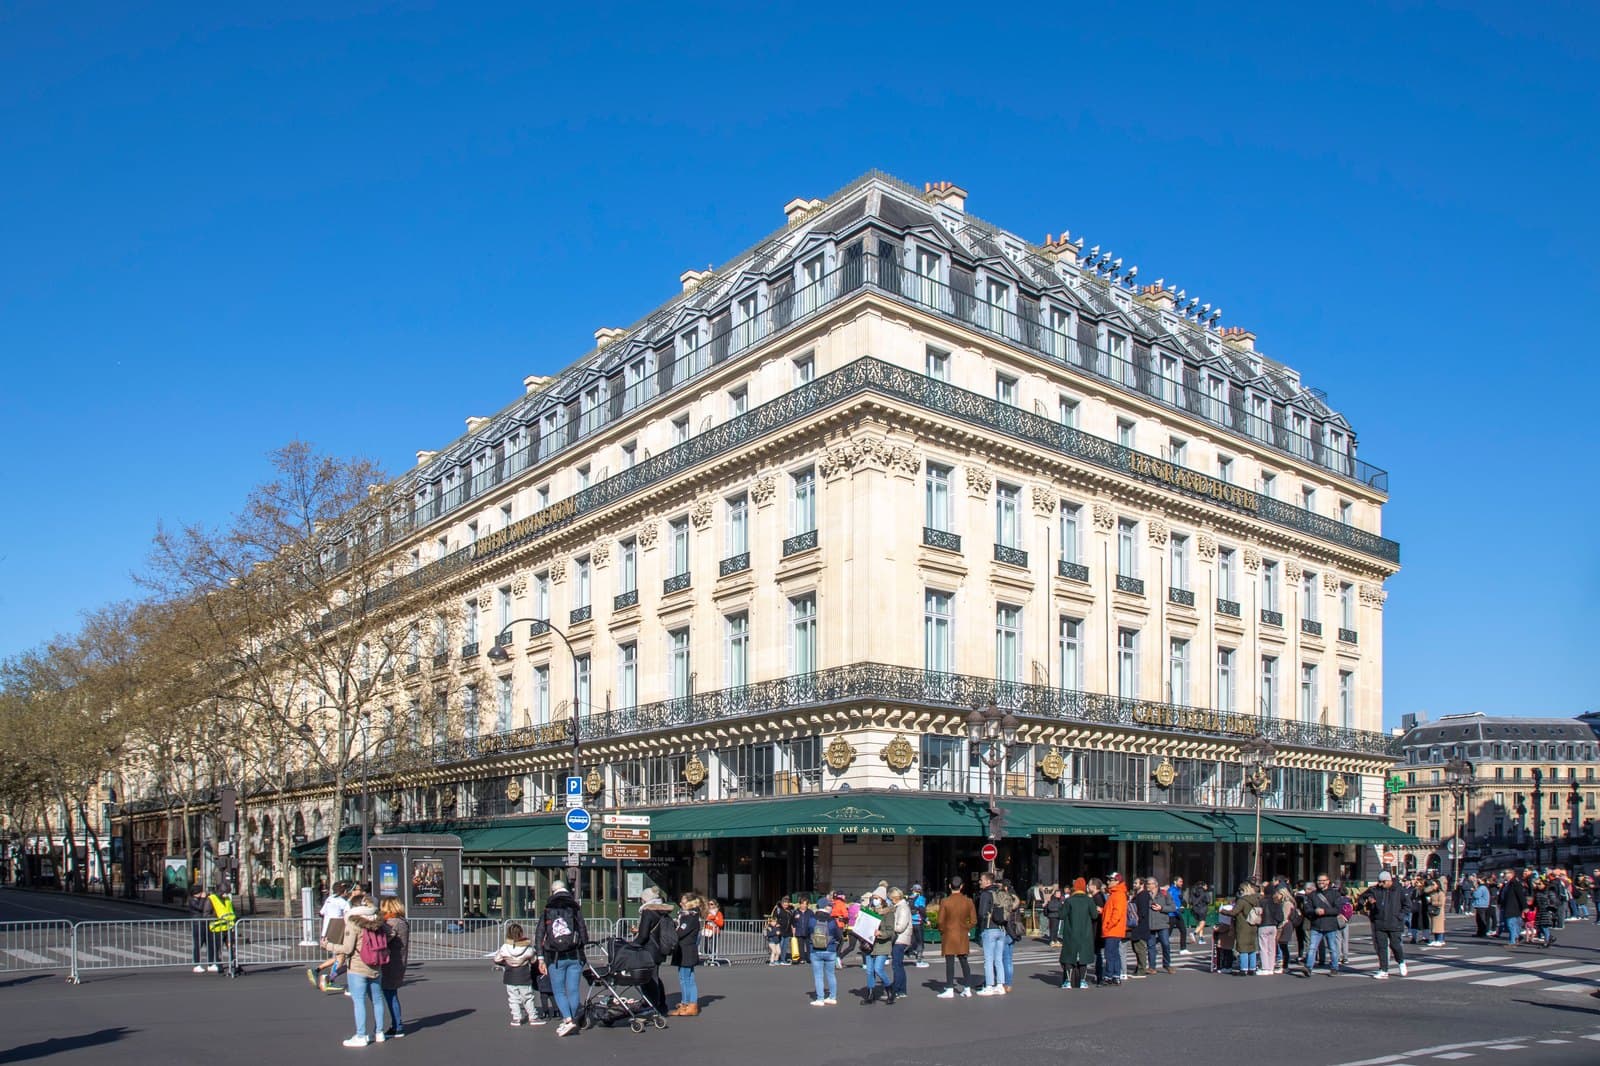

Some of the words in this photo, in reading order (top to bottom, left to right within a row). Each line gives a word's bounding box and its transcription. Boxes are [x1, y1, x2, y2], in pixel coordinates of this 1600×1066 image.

[1130, 451, 1149, 474] LE
[1151, 459, 1209, 494] GRAND
[570, 780, 578, 792] P
